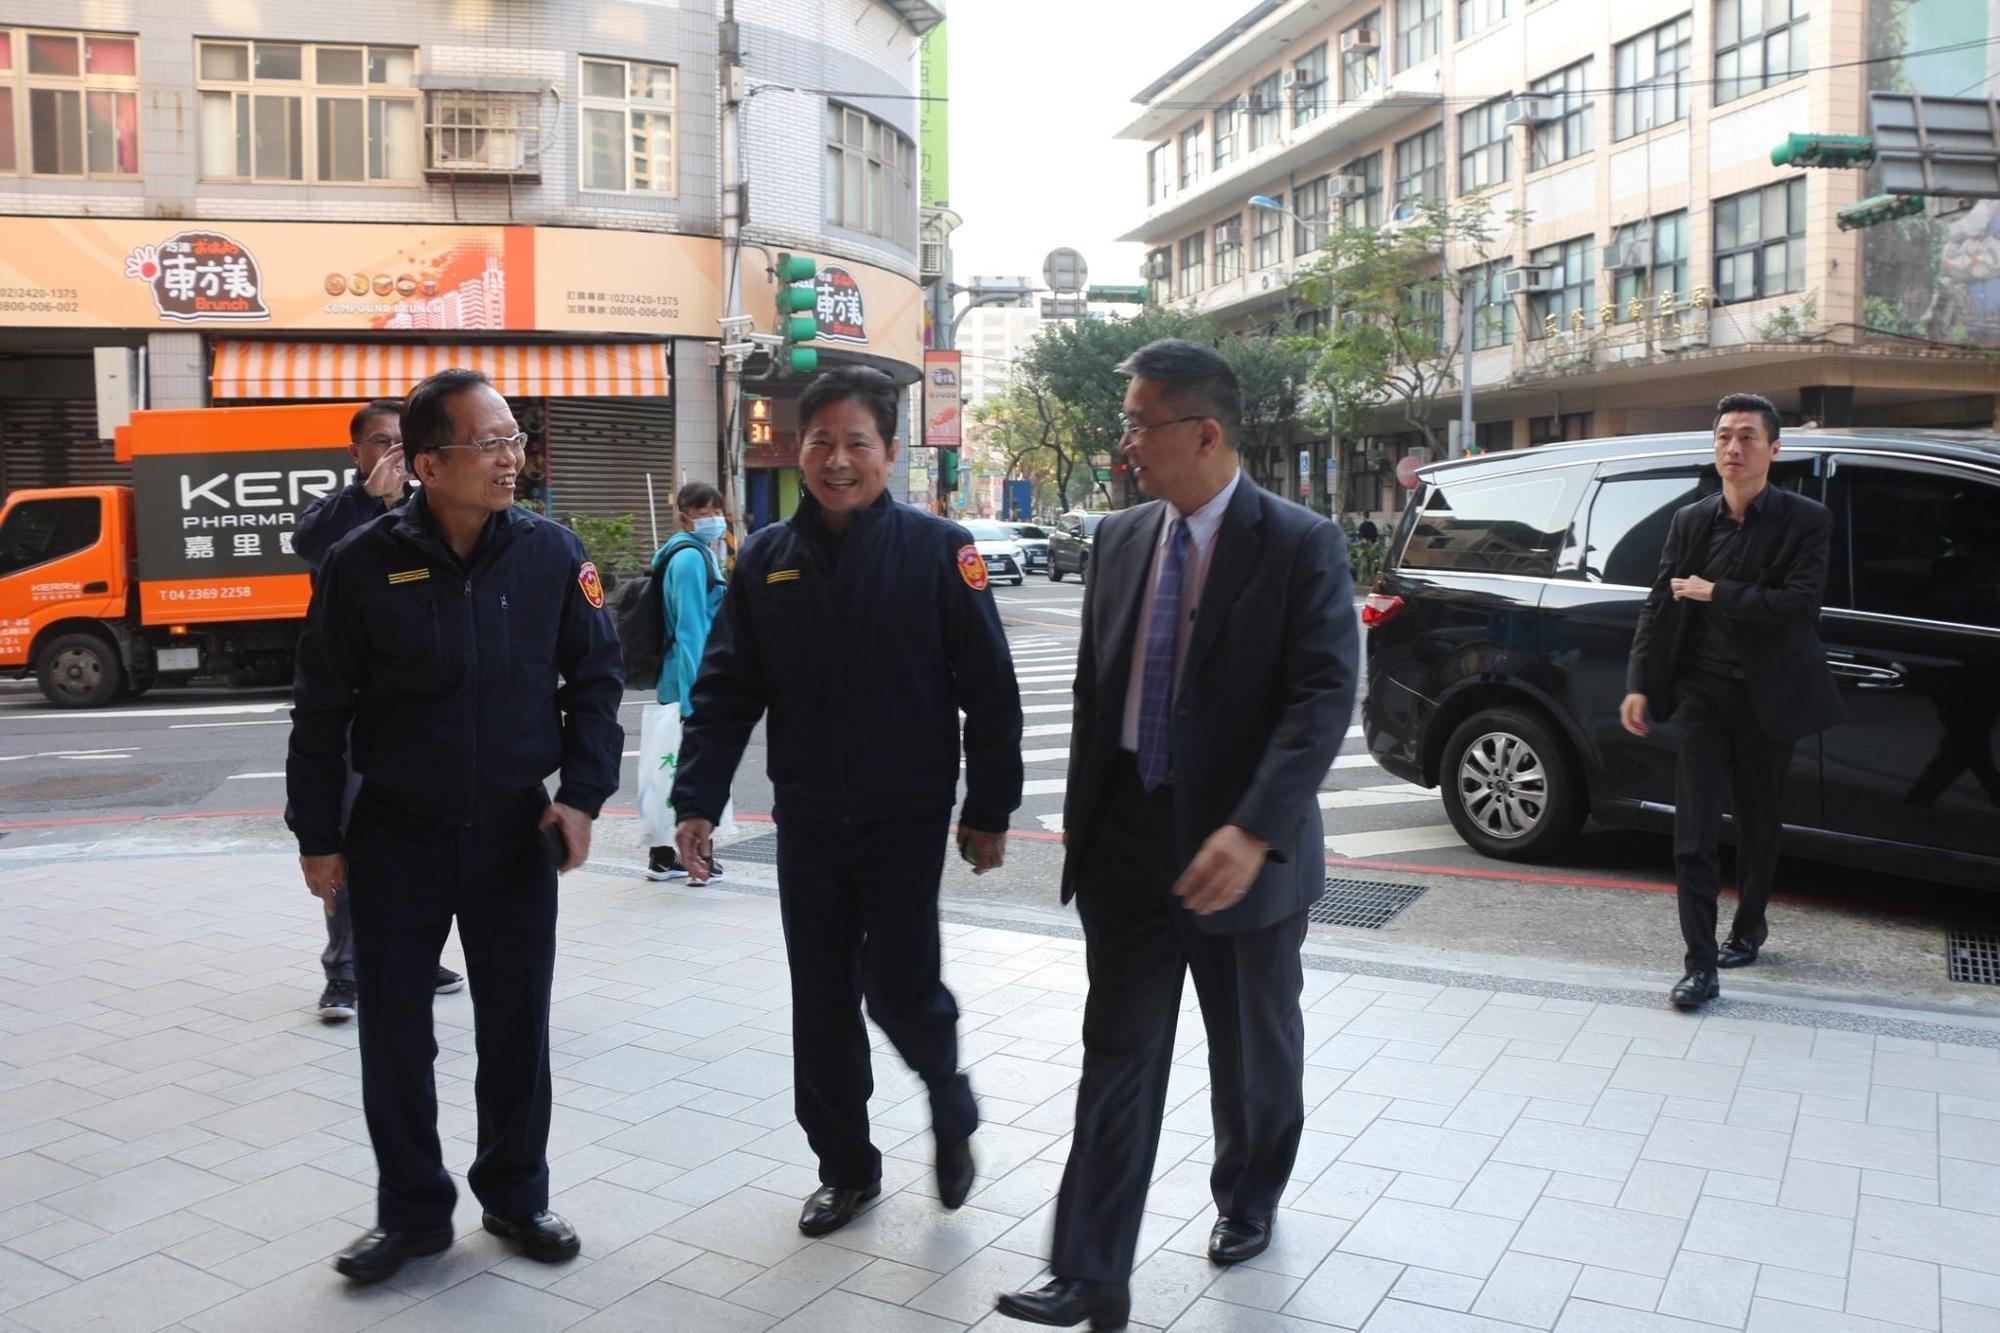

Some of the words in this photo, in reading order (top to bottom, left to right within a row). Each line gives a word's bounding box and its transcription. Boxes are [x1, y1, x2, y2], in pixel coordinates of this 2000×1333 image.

[162, 254, 256, 300] 東方美
[195, 297, 249, 311] Brunch
[816, 283, 863, 326] 東方美
[752, 423, 770, 443] 31
[182, 512, 296, 530] PHARMA
[159, 590, 167, 601] T
[169, 589, 185, 601] 04
[187, 587, 218, 600] 2369
[220, 586, 252, 599] 2258
